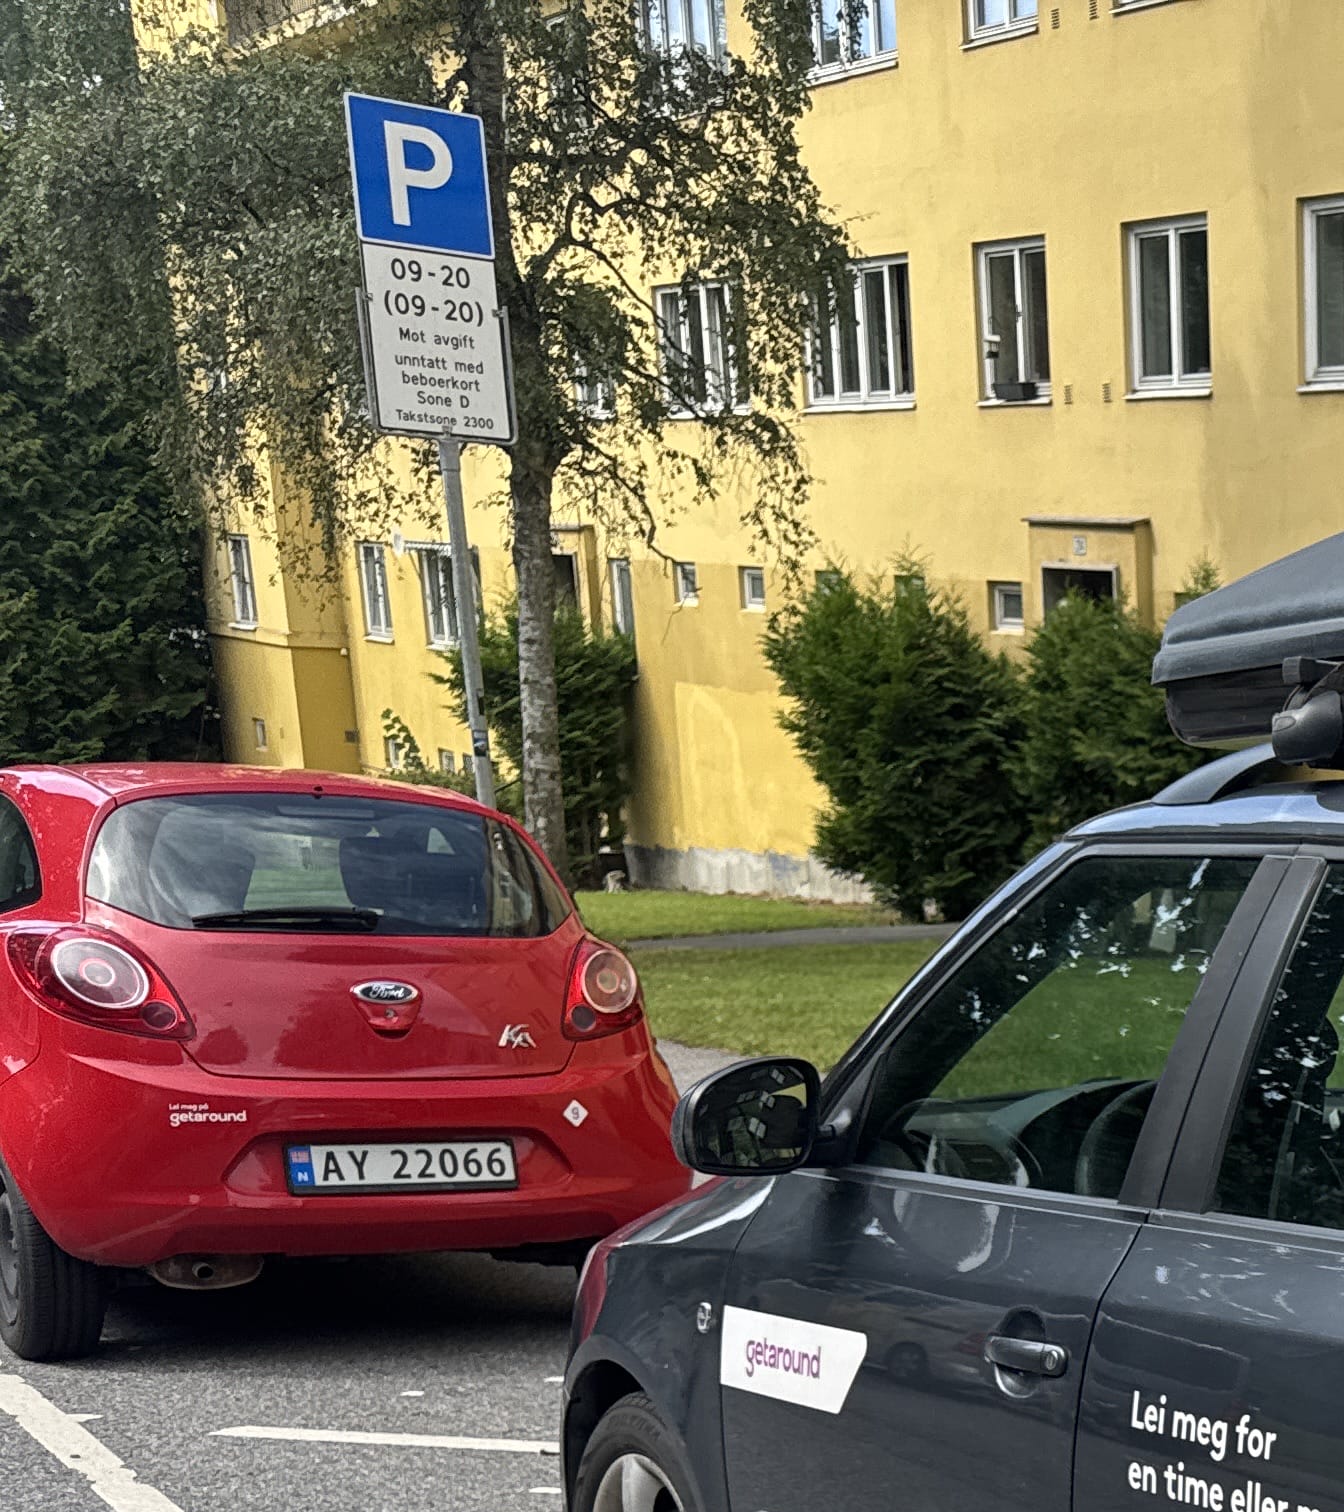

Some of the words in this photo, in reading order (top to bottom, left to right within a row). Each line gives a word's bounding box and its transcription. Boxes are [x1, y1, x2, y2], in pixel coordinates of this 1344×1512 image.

[384, 120, 453, 226] P
[399, 328, 426, 344] Mot
[434, 332, 475, 350] avgift
[395, 354, 448, 371] unntatt
[455, 358, 484, 375] med
[401, 373, 481, 392] beboerkort
[417, 391, 452, 408] Sone
[460, 395, 470, 409] D
[396, 409, 457, 426] Takstsone
[463, 415, 494, 430] 2300
[169, 1109, 248, 1127] getaround
[322, 1150, 369, 1182] AY
[390, 1148, 507, 1180] 22066
[745, 1337, 822, 1380] getaround
[1130, 1390, 1168, 1435] Lei
[1171, 1409, 1228, 1462] meg
[1235, 1414, 1277, 1461] for
[1128, 1461, 1157, 1494] en
[1164, 1462, 1224, 1512] time
